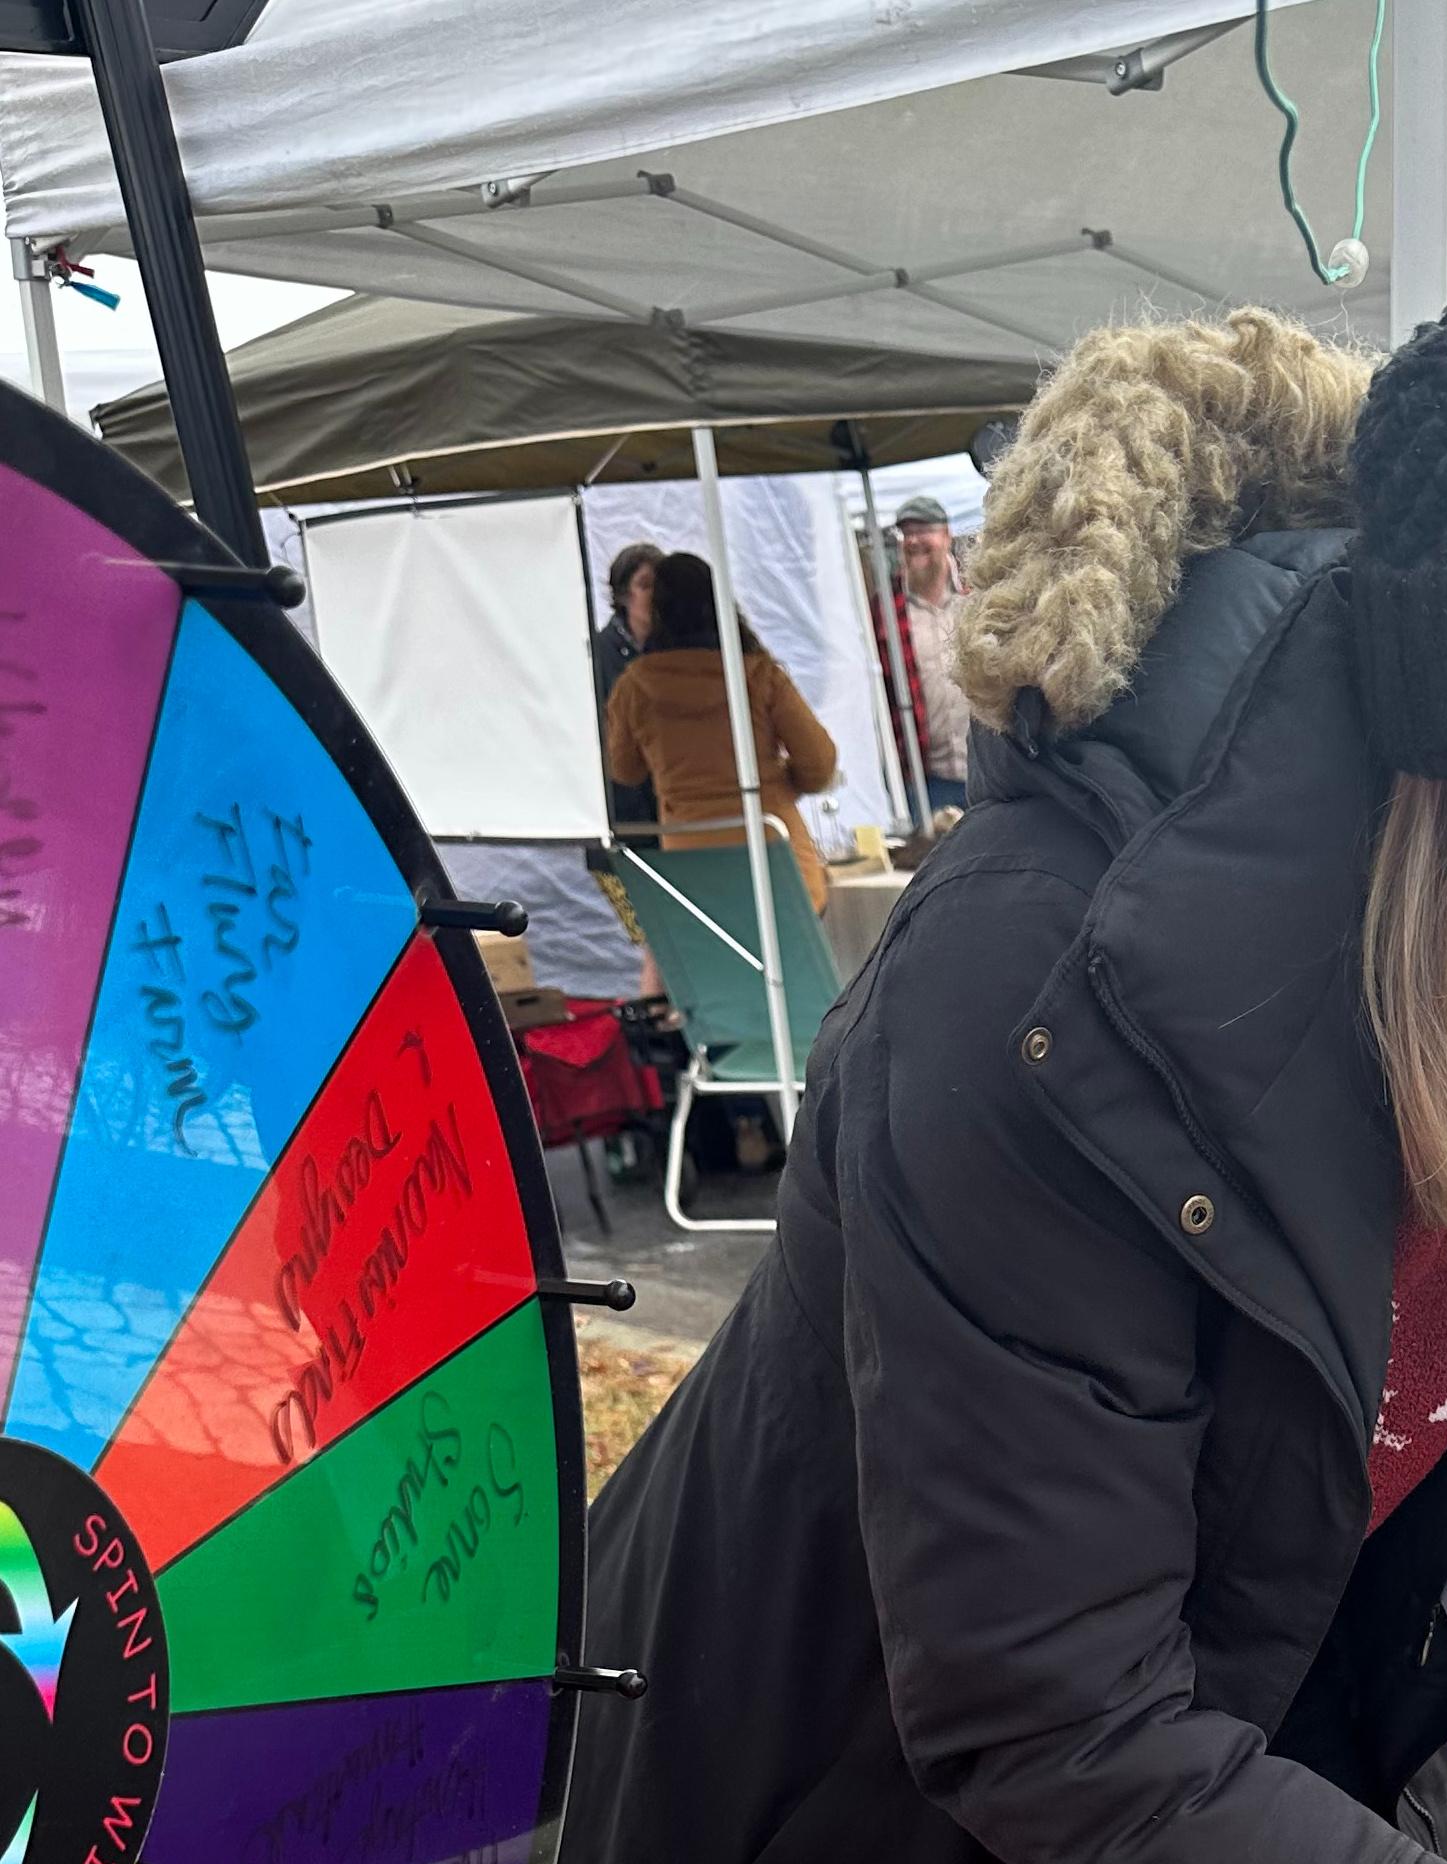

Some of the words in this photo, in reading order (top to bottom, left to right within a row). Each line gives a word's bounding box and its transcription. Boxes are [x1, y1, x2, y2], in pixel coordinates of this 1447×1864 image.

[195, 800, 260, 1046] Flung
[262, 804, 312, 972] Far
[131, 901, 207, 1158] Farm
[352, 1389, 463, 1622] Studios
[73, 1513, 154, 1660] SPIN
[122, 1672, 157, 1766] TO
